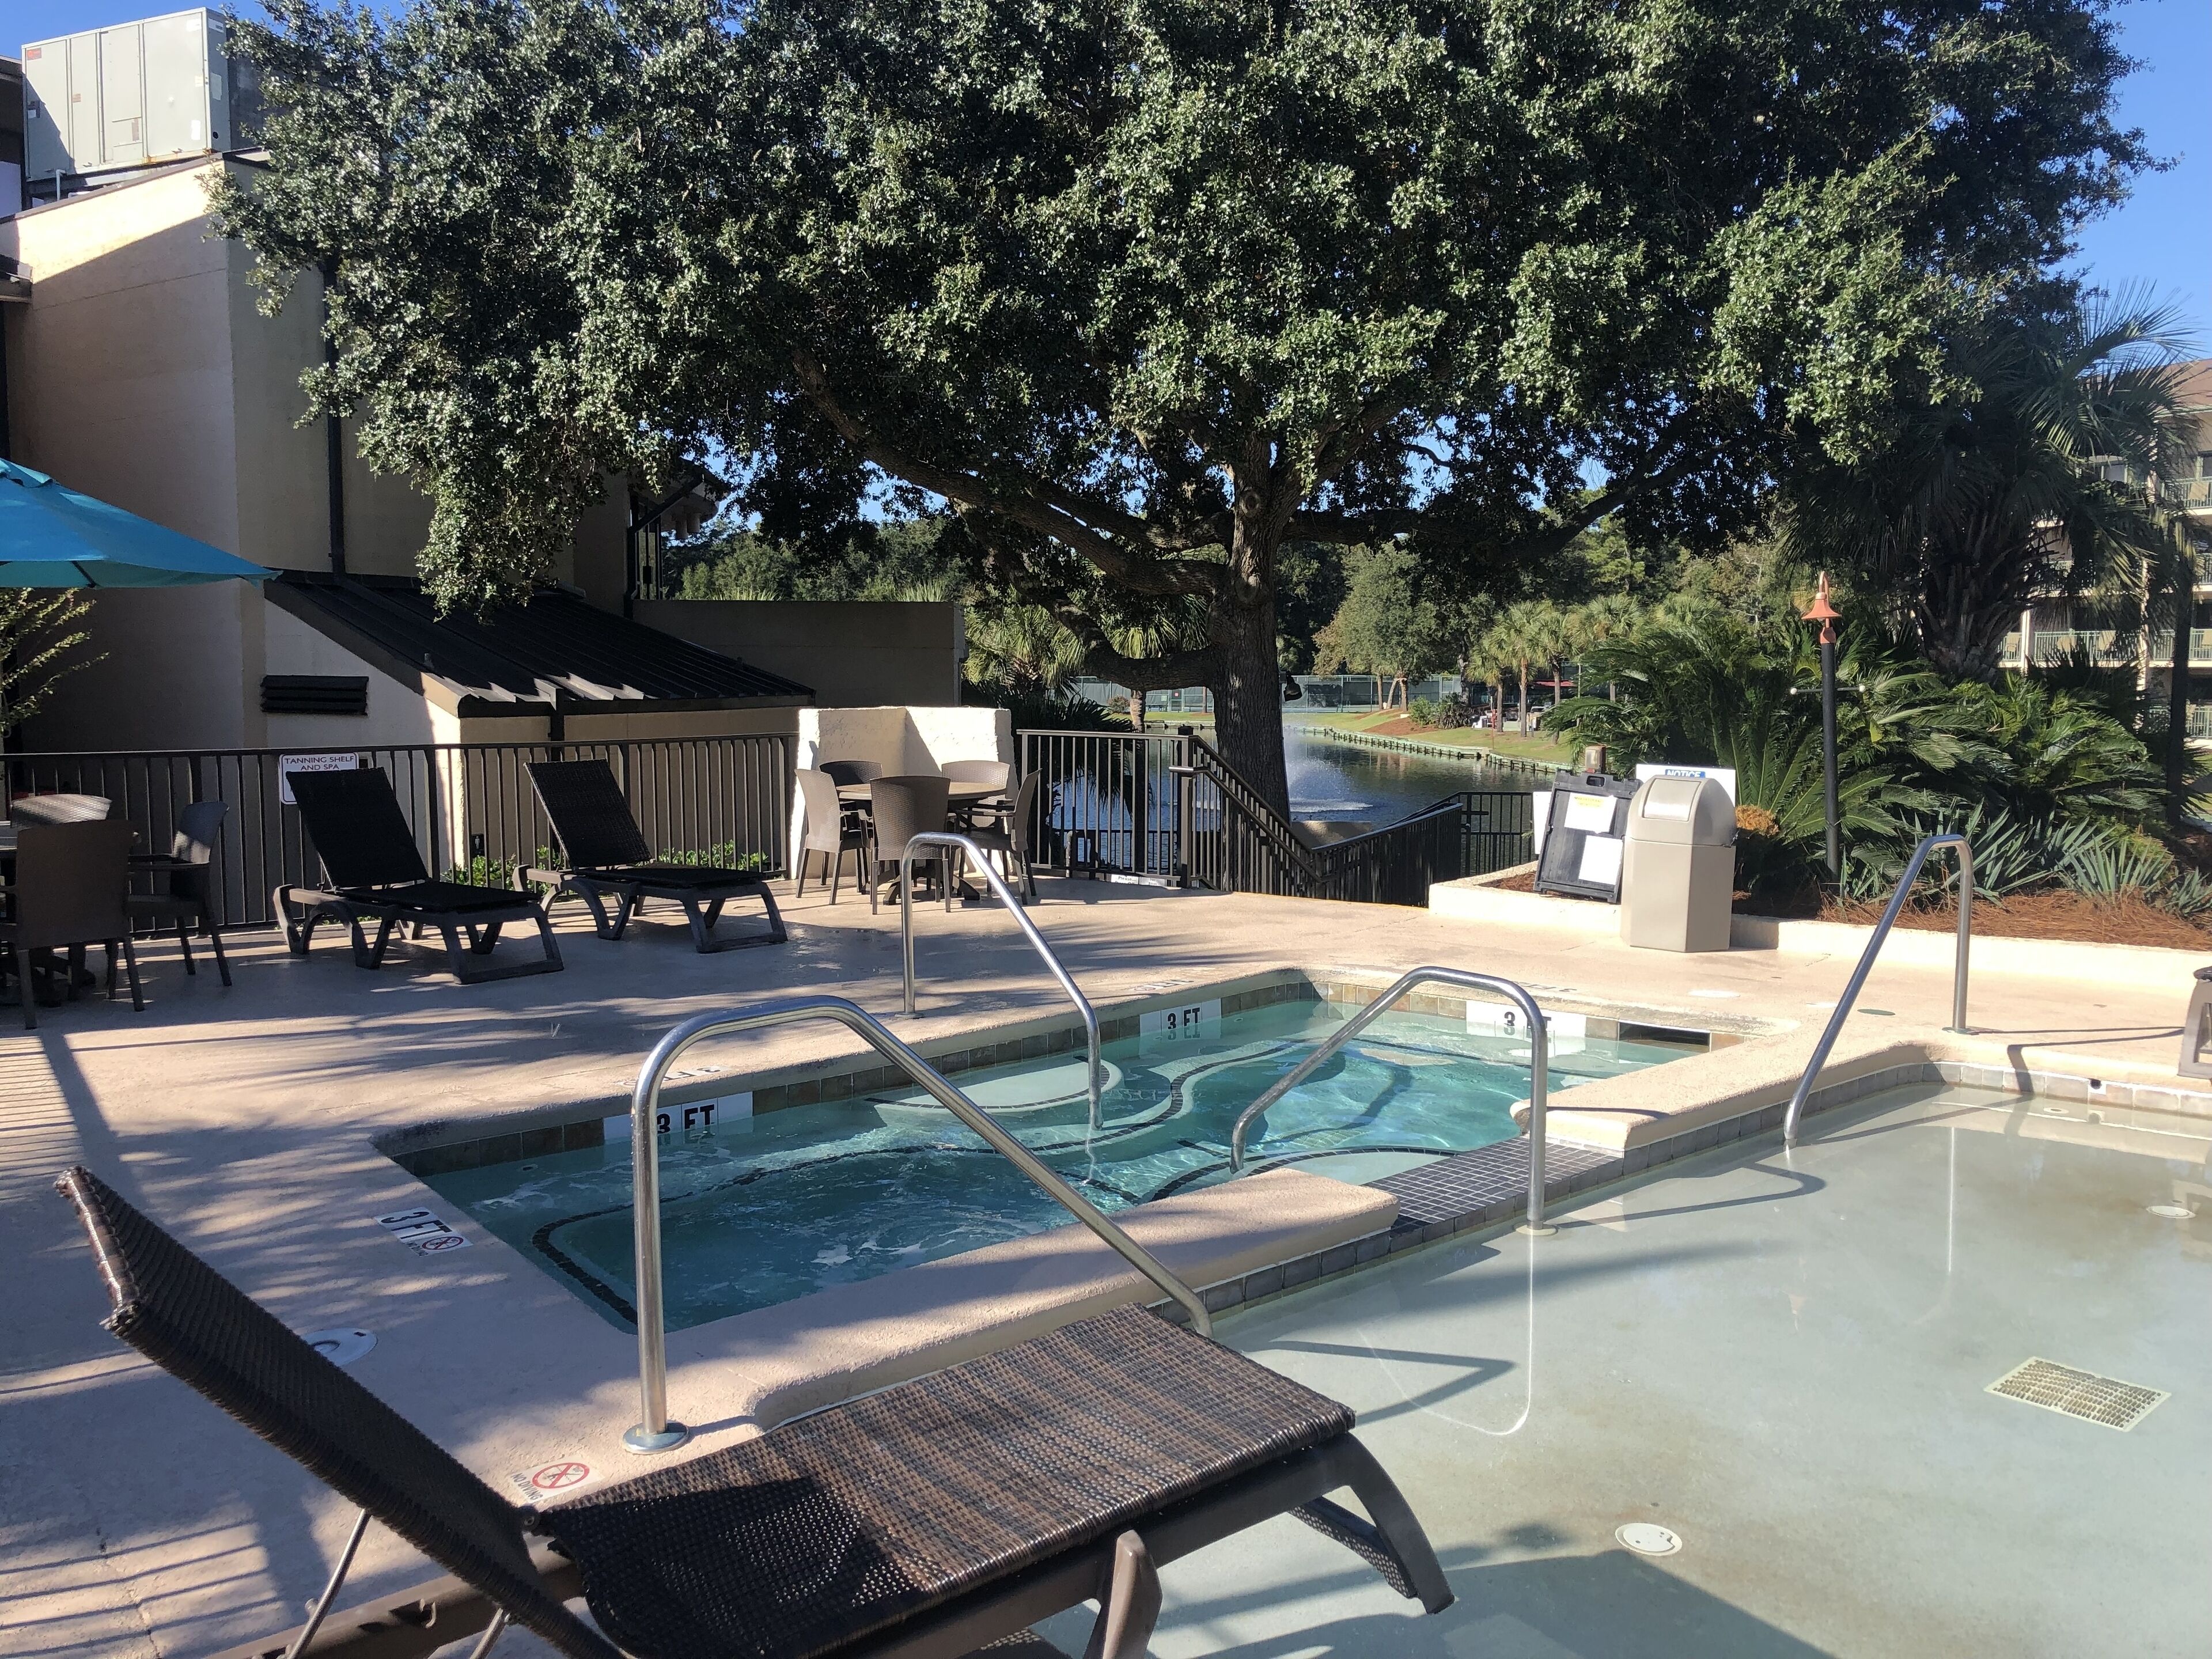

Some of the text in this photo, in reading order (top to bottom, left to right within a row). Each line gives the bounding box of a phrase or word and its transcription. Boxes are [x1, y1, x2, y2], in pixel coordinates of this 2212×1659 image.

[1167, 1007, 1200, 1029] 3 FT
[1503, 1011, 1516, 1027] 3
[657, 1104, 715, 1134] 3 FT
[380, 1211, 453, 1239] 3 FT
[510, 1472, 544, 1501] NO DIVING
